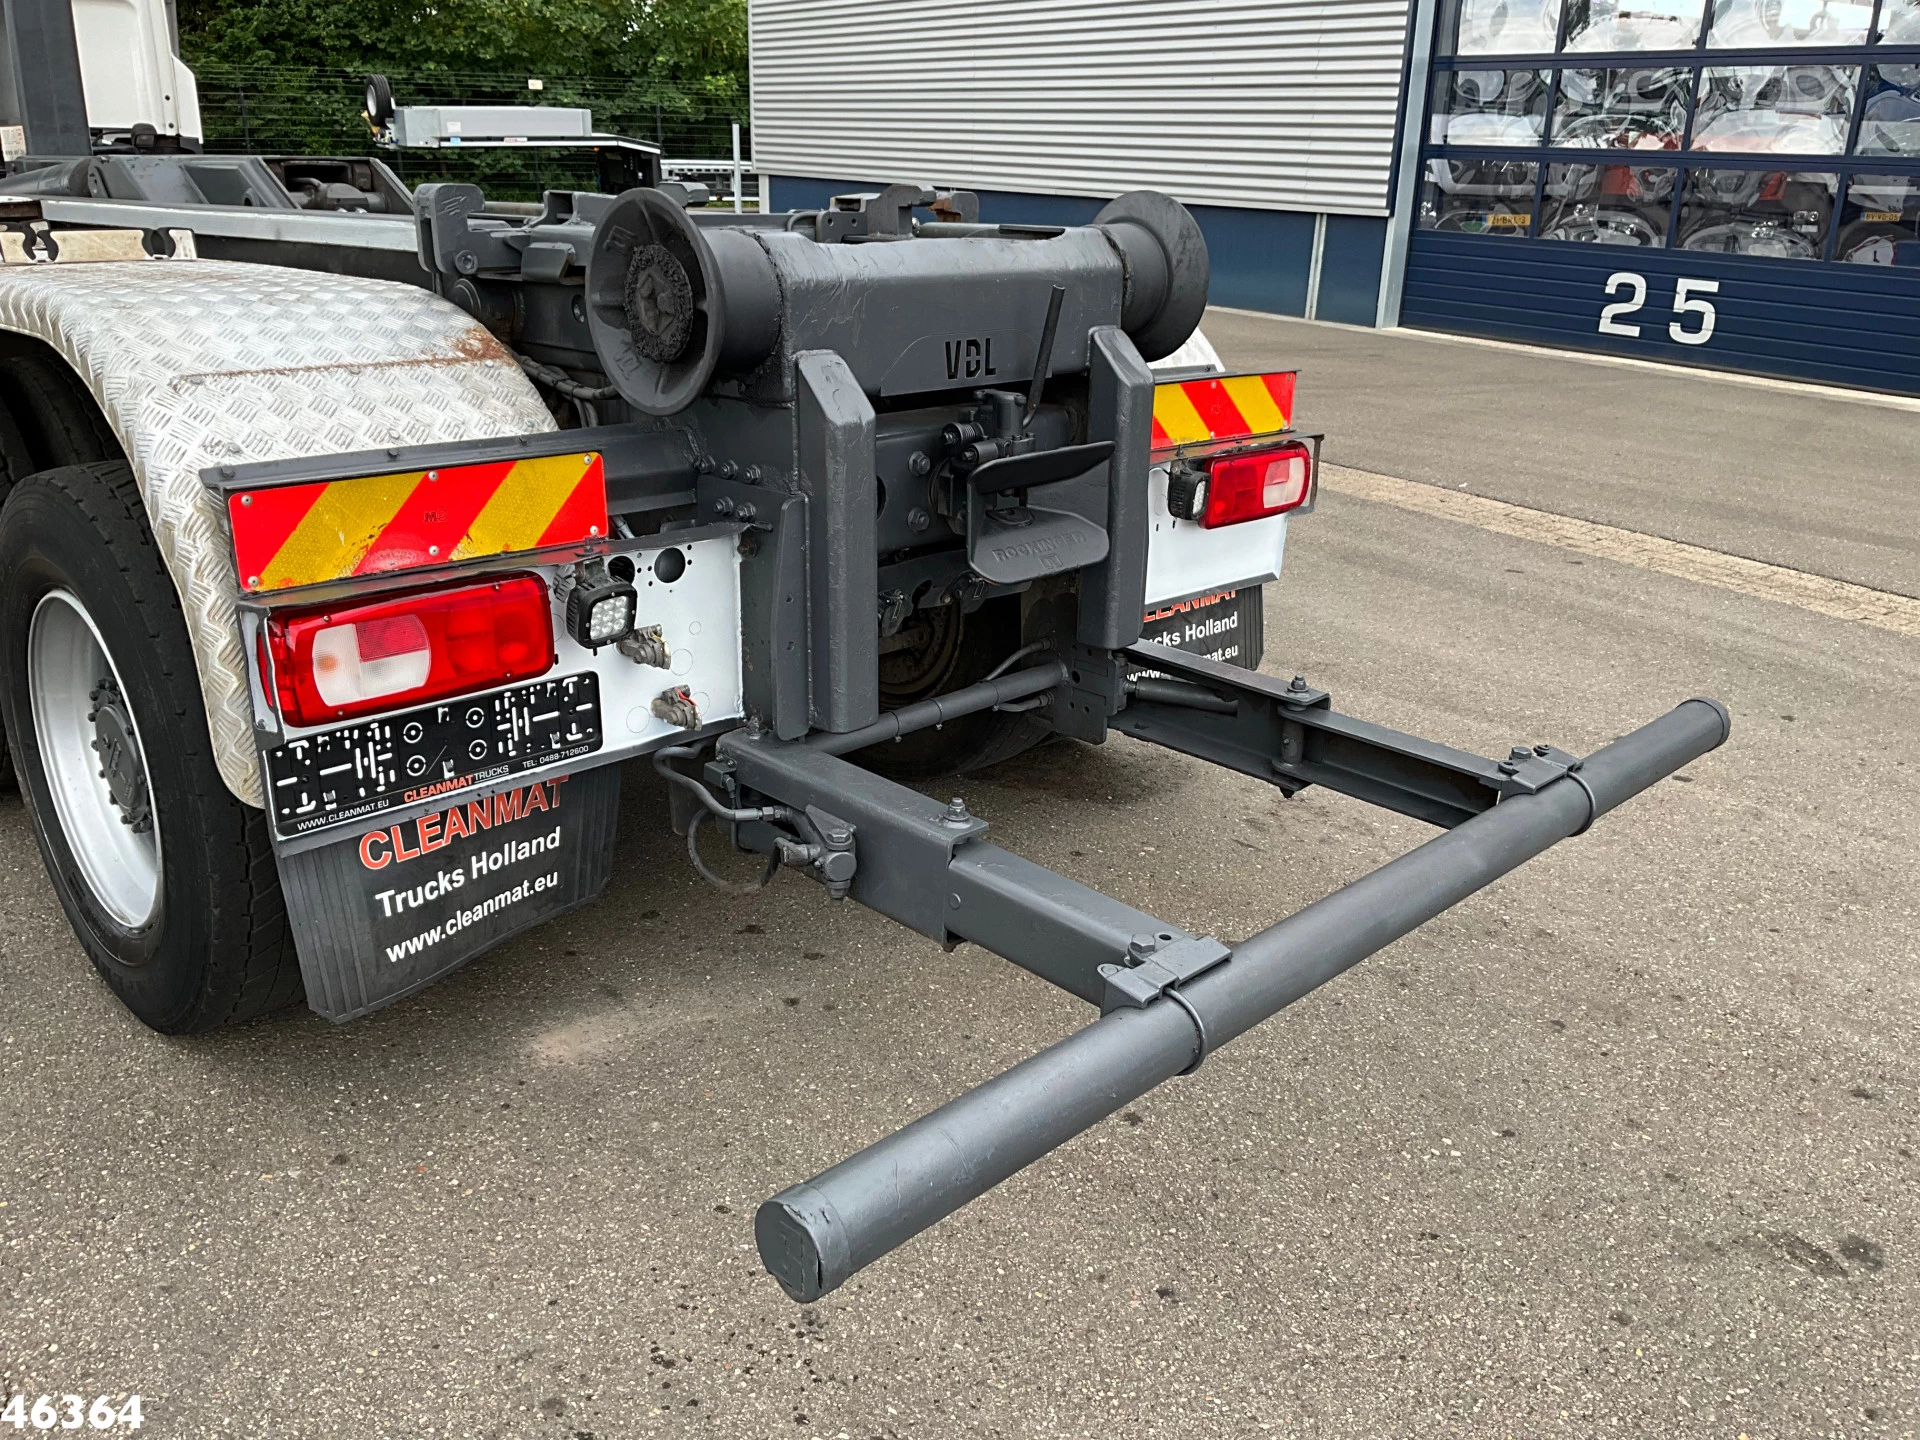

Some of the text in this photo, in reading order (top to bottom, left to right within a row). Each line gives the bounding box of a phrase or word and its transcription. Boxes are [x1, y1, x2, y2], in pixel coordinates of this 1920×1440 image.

[945, 338, 996, 379] VDL
[1185, 611, 1238, 642] Holland
[297, 799, 389, 832] WWW.CLEANMAT.EU
[522, 759, 538, 769] TEL:
[359, 774, 570, 870] CLEANMAT
[375, 826, 561, 918] Trucks Holland
[386, 872, 558, 963] www.cleanmat.eu
